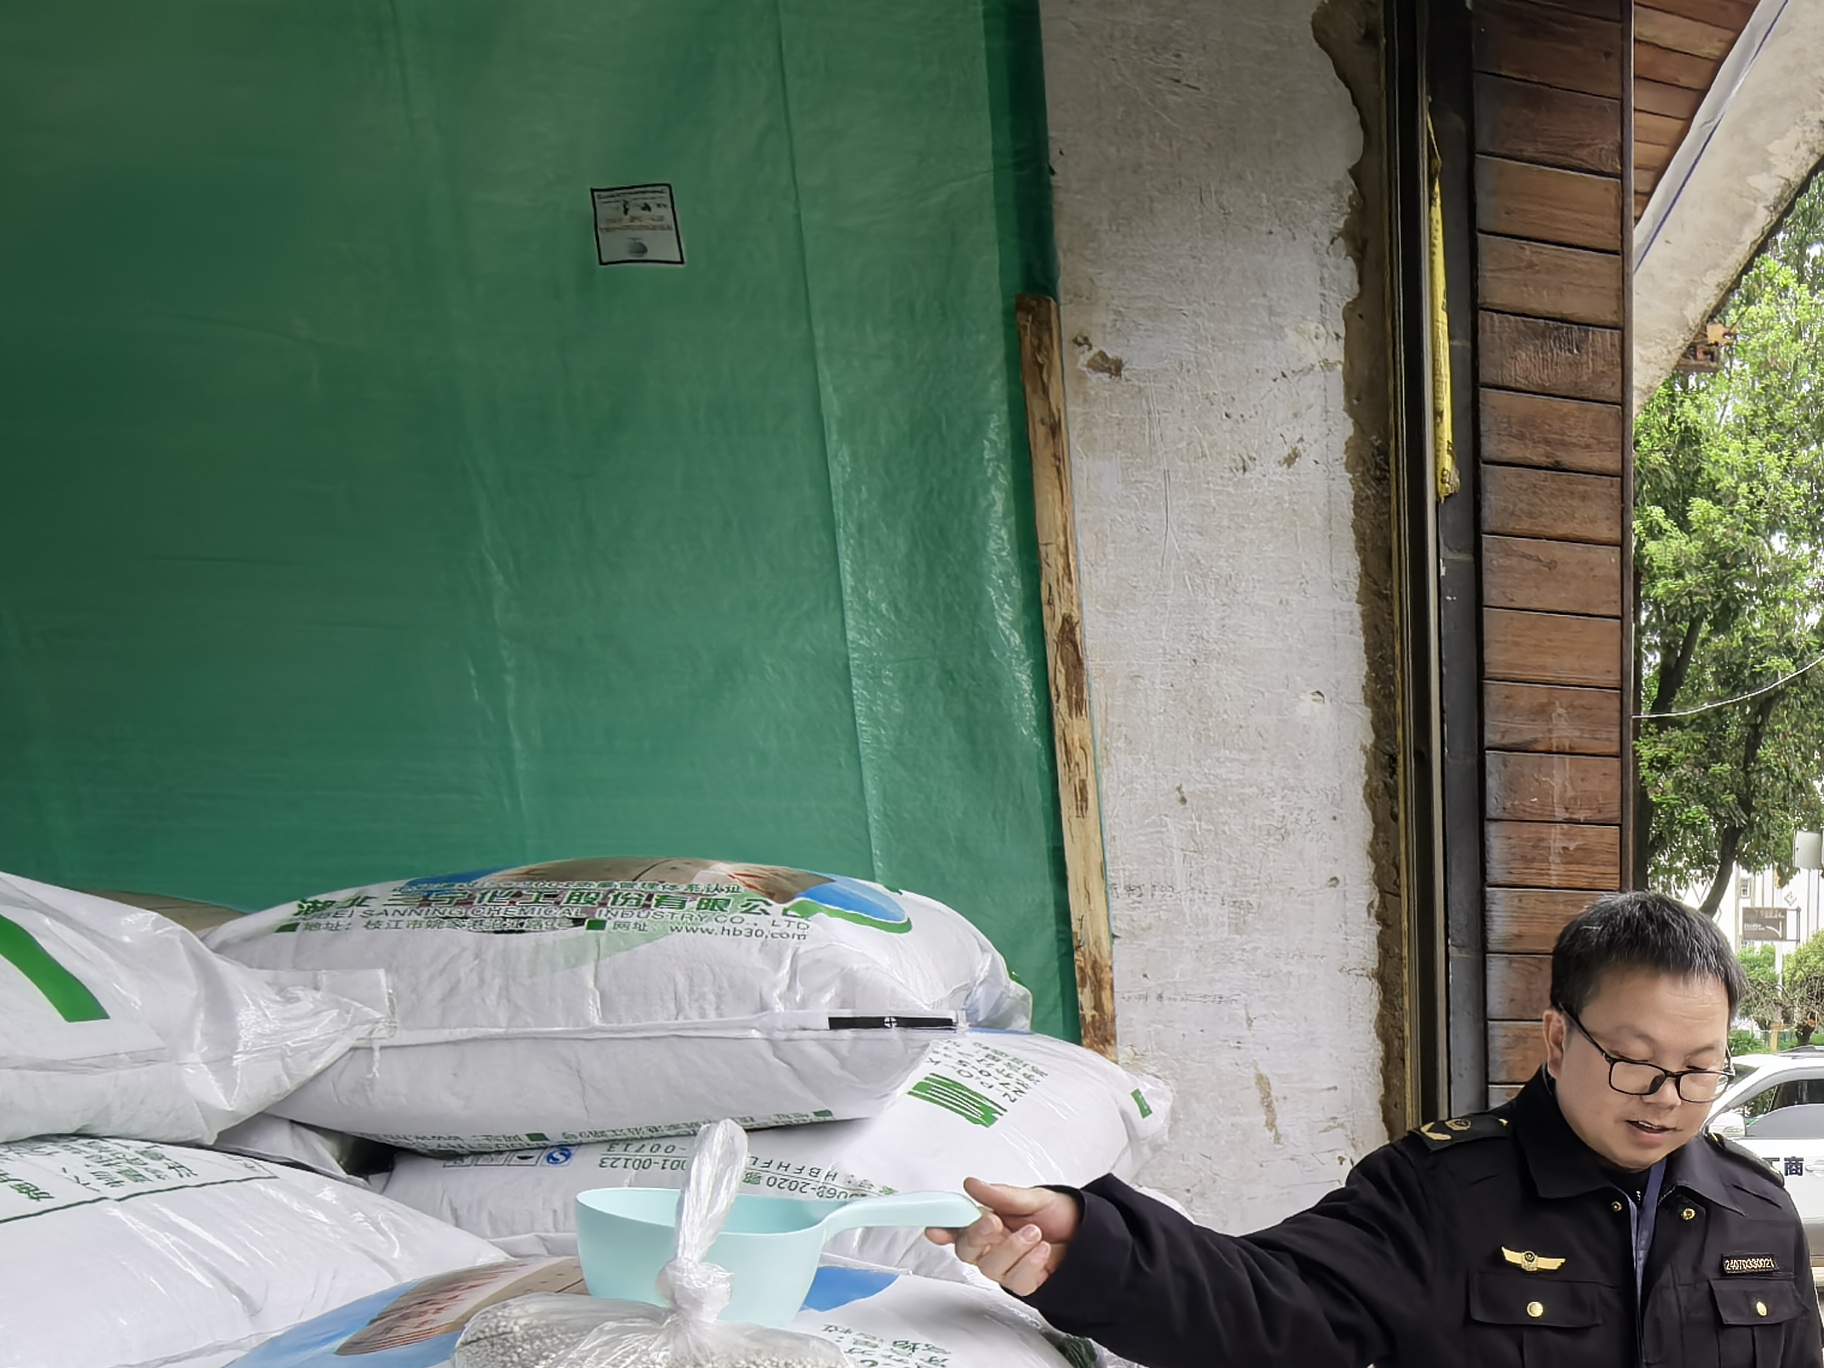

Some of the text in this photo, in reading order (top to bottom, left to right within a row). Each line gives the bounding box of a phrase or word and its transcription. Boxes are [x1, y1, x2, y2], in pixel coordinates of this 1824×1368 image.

[358, 906, 463, 919] SANNING
[470, 906, 586, 919] CHEMICAL
[597, 908, 710, 923] INDUSTRY
[771, 918, 810, 931] LTD
[670, 924, 808, 941] www.hb30.com
